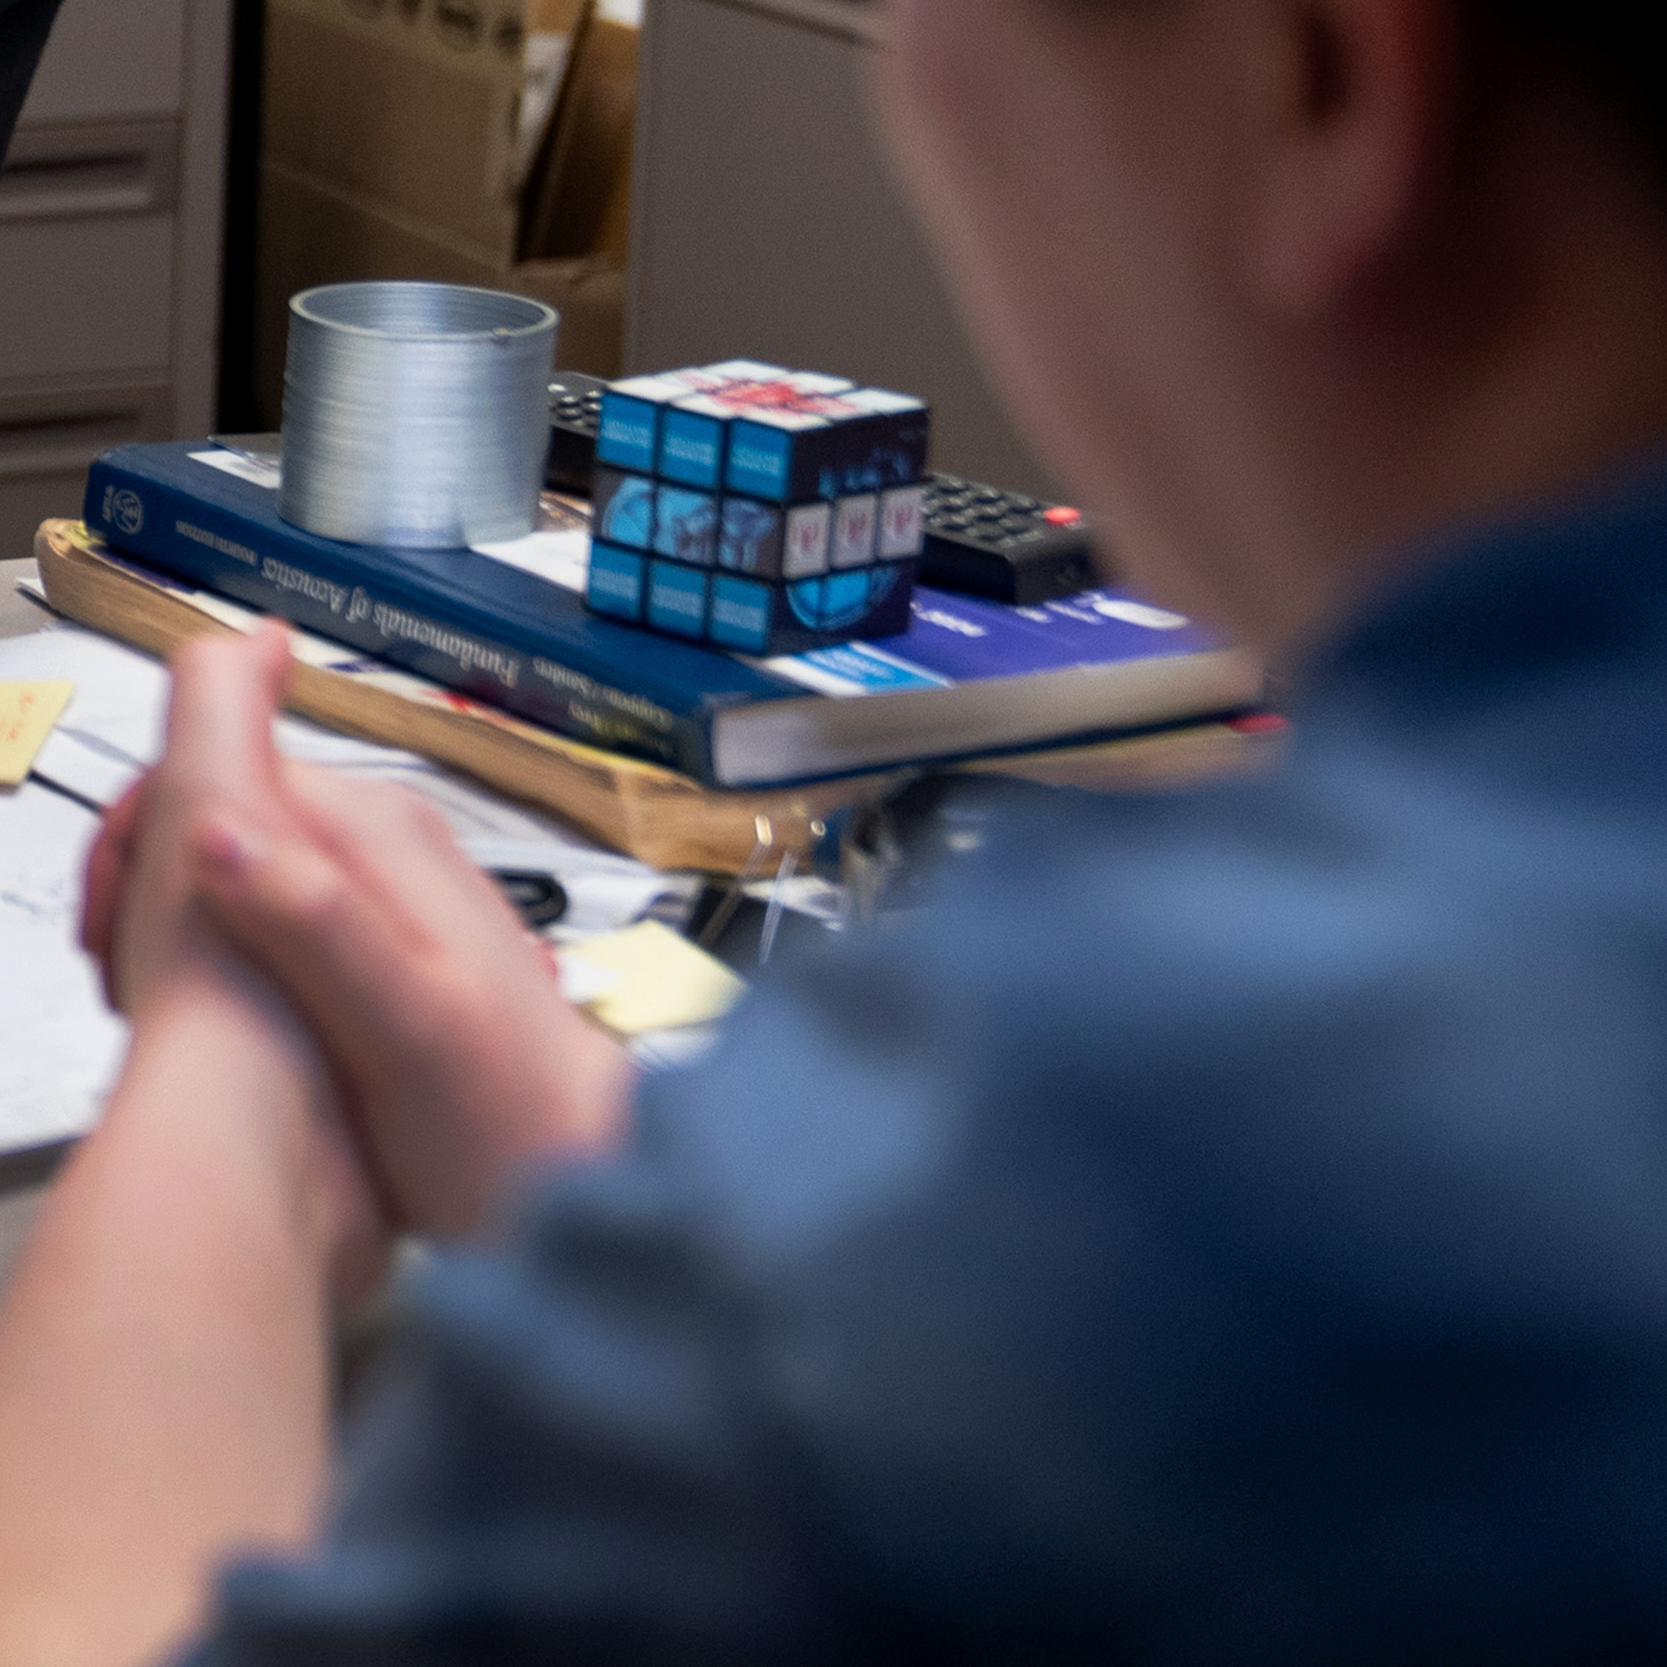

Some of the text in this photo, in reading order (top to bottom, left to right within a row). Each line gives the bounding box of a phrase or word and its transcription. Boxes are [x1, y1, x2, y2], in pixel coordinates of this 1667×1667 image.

[261, 555, 519, 689] Fundamentals of Acoustics
